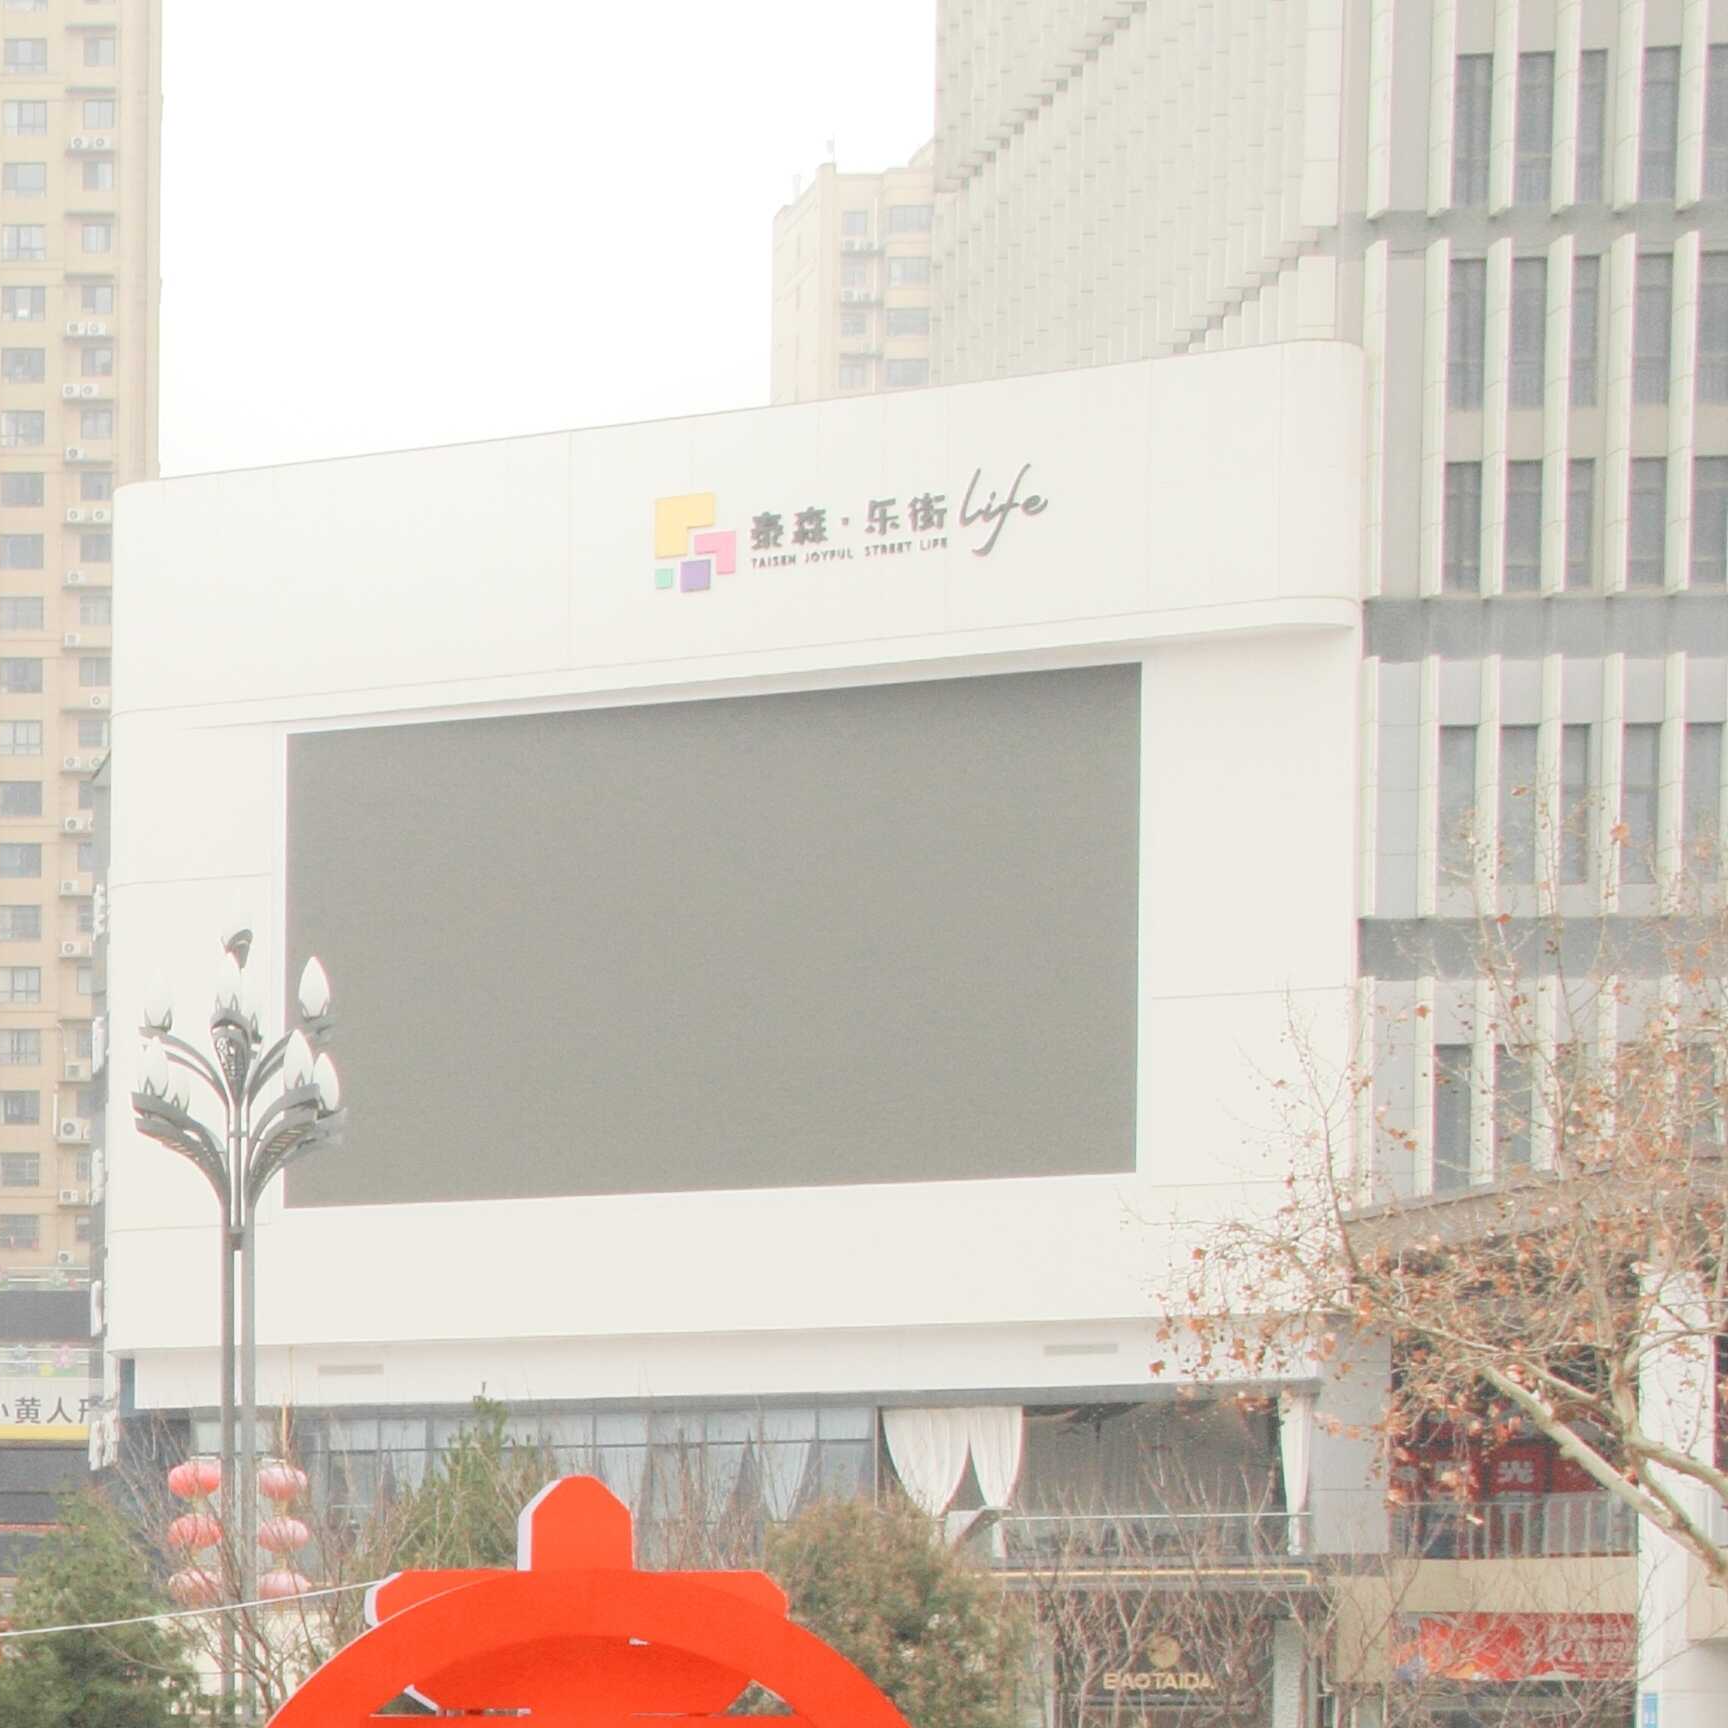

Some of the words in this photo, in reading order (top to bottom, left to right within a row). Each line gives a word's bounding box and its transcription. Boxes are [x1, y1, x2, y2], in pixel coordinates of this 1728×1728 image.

[749, 493, 947, 551] 泰森·乐街
[751, 555, 796, 569] TAISEN
[805, 549, 854, 564] JOYFUL
[865, 541, 912, 557] STREET
[920, 537, 948, 551] LIFE
